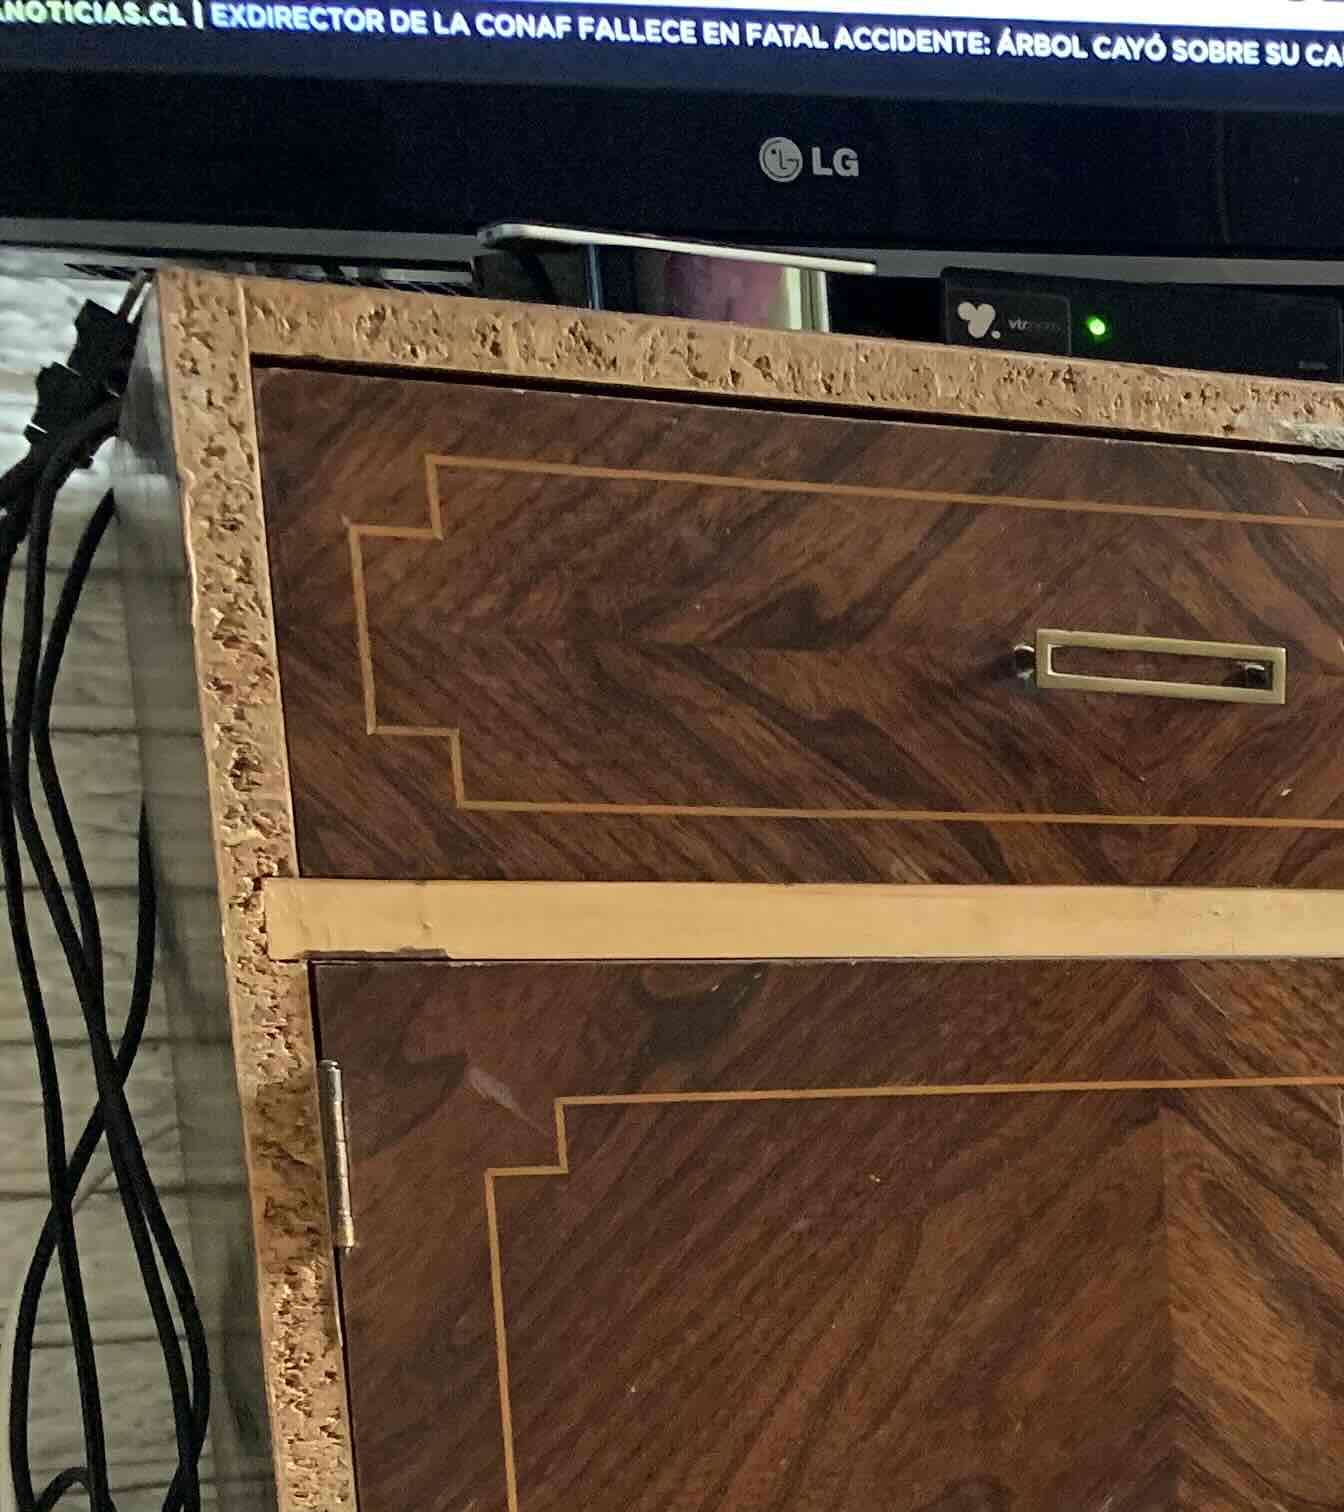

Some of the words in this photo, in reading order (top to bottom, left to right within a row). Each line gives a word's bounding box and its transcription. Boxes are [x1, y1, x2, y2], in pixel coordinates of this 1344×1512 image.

[0, 0, 187, 27] NOTICIAS.CL
[210, 7, 387, 33] EXDIRECTOR
[390, 10, 429, 35] DE
[433, 11, 471, 37] LA
[475, 13, 572, 40] CONAF
[578, 16, 698, 45] FALLECE
[702, 20, 740, 47] EN
[746, 22, 829, 50] FATAL
[834, 25, 991, 56] ACCIDENTE:
[997, 27, 1089, 59] ÁRBOL
[1091, 32, 1168, 63] CAYÓ
[1171, 37, 1260, 66] SOBRE
[1265, 40, 1300, 67] SU
[811, 146, 859, 176] LG
